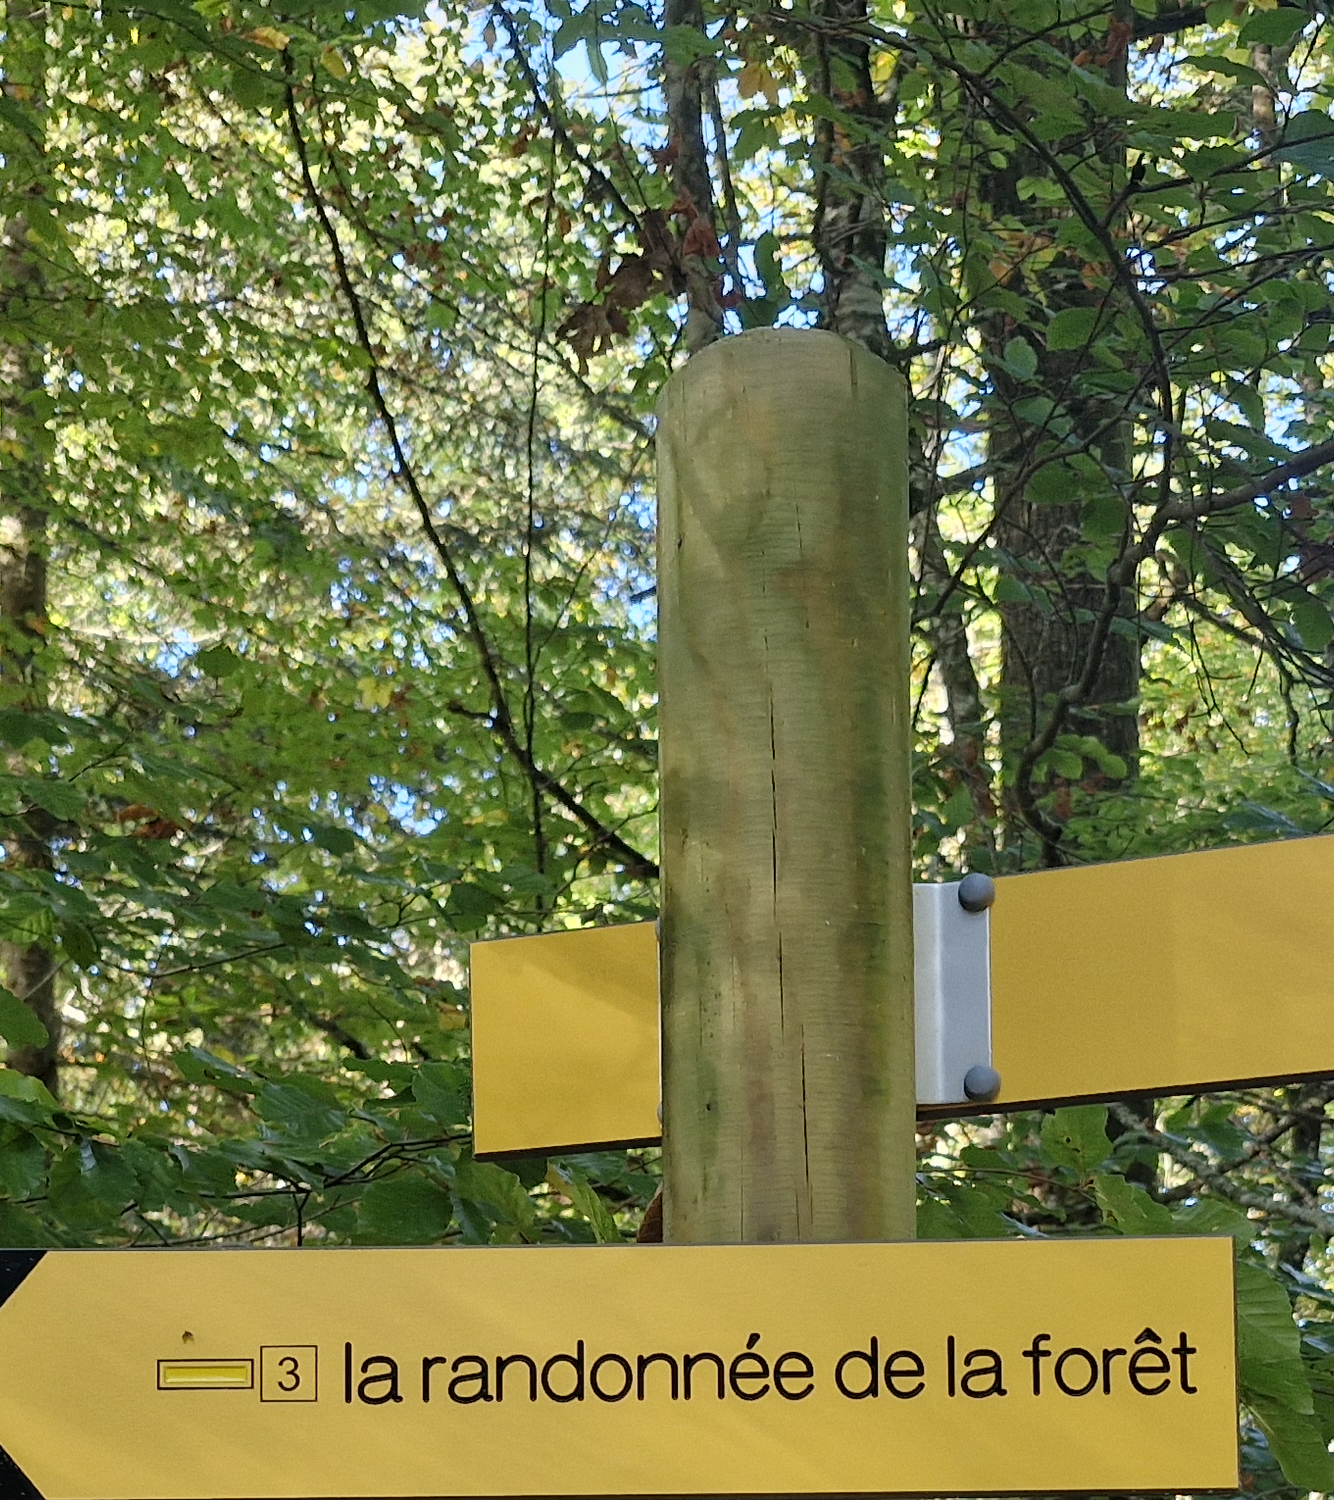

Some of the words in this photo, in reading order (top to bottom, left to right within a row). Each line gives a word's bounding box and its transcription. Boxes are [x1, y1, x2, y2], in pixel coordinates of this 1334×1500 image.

[277, 1356, 301, 1392] 3
[344, 1341, 404, 1406] la
[422, 1332, 815, 1405] randonnée
[834, 1335, 926, 1401] de
[947, 1335, 1008, 1399] la
[1021, 1326, 1198, 1398] forêt
